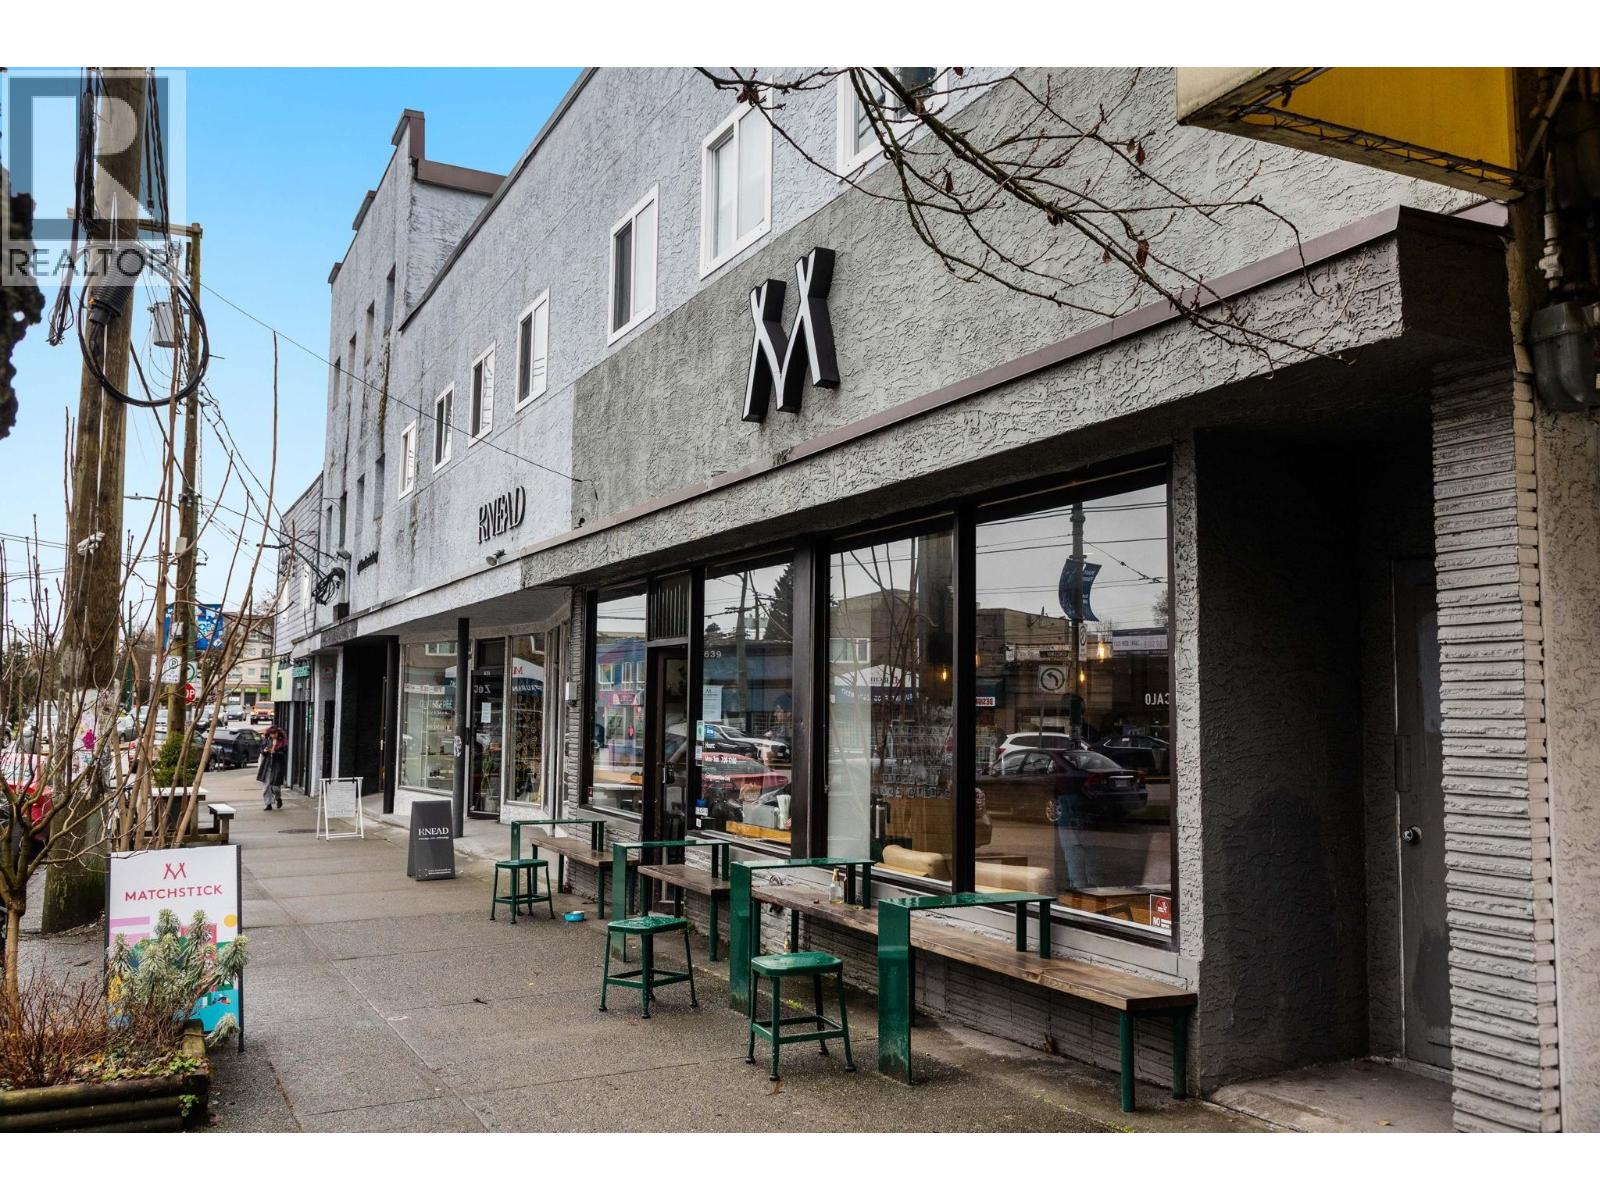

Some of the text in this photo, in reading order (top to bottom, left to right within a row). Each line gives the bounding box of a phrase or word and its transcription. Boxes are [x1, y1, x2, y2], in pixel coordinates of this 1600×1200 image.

[478, 486, 526, 543] KNEAD
[418, 827, 449, 837] KNEAD
[124, 884, 223, 901] MATCHSTICK
